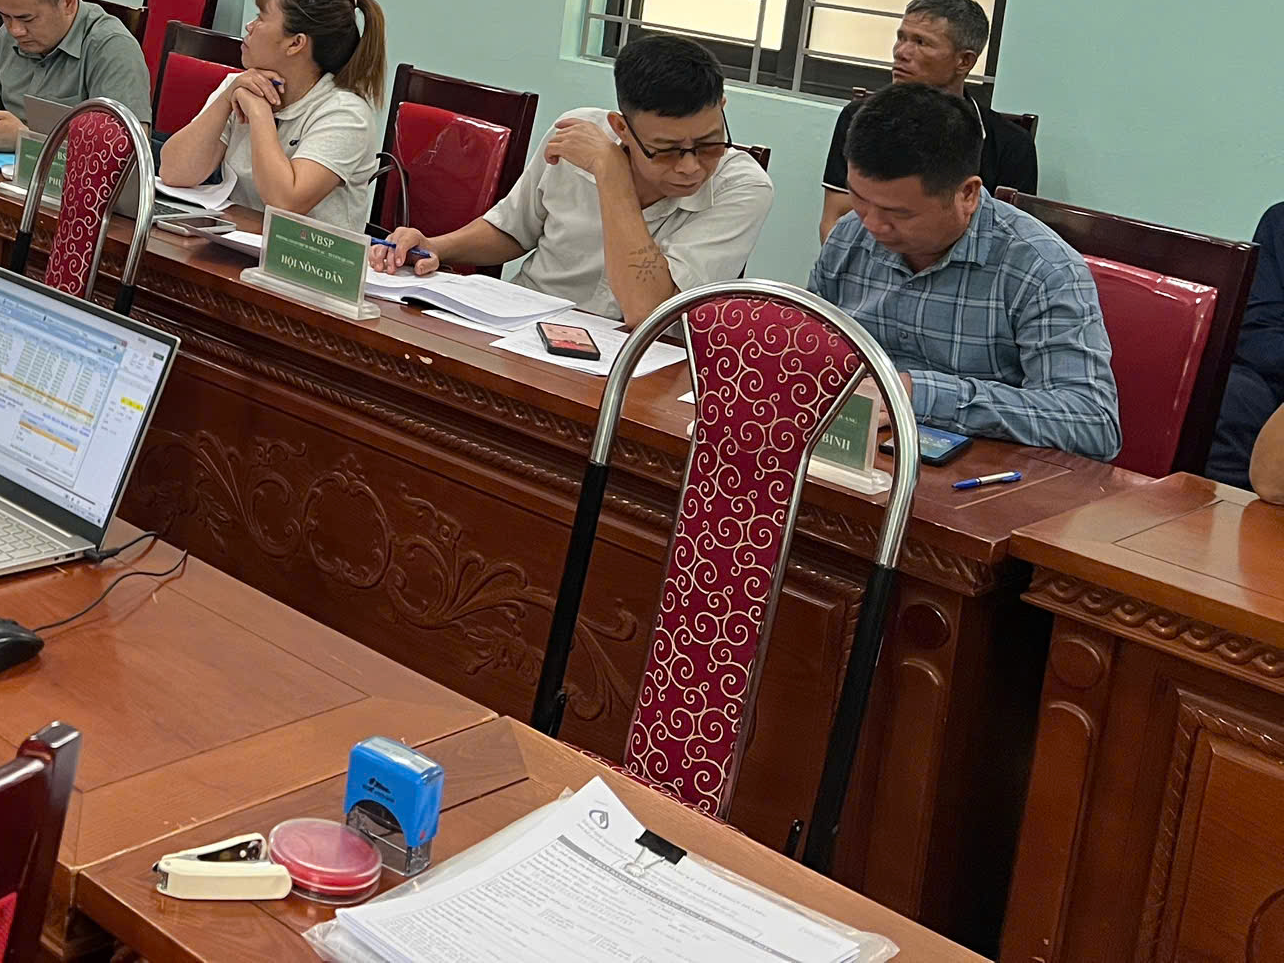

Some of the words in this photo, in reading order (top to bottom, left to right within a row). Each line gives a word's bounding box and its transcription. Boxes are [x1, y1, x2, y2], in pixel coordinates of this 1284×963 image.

[310, 232, 335, 249] VBSP
[280, 254, 298, 268] HỘI
[298, 260, 324, 278] NÔNG
[324, 269, 344, 285] DÂN
